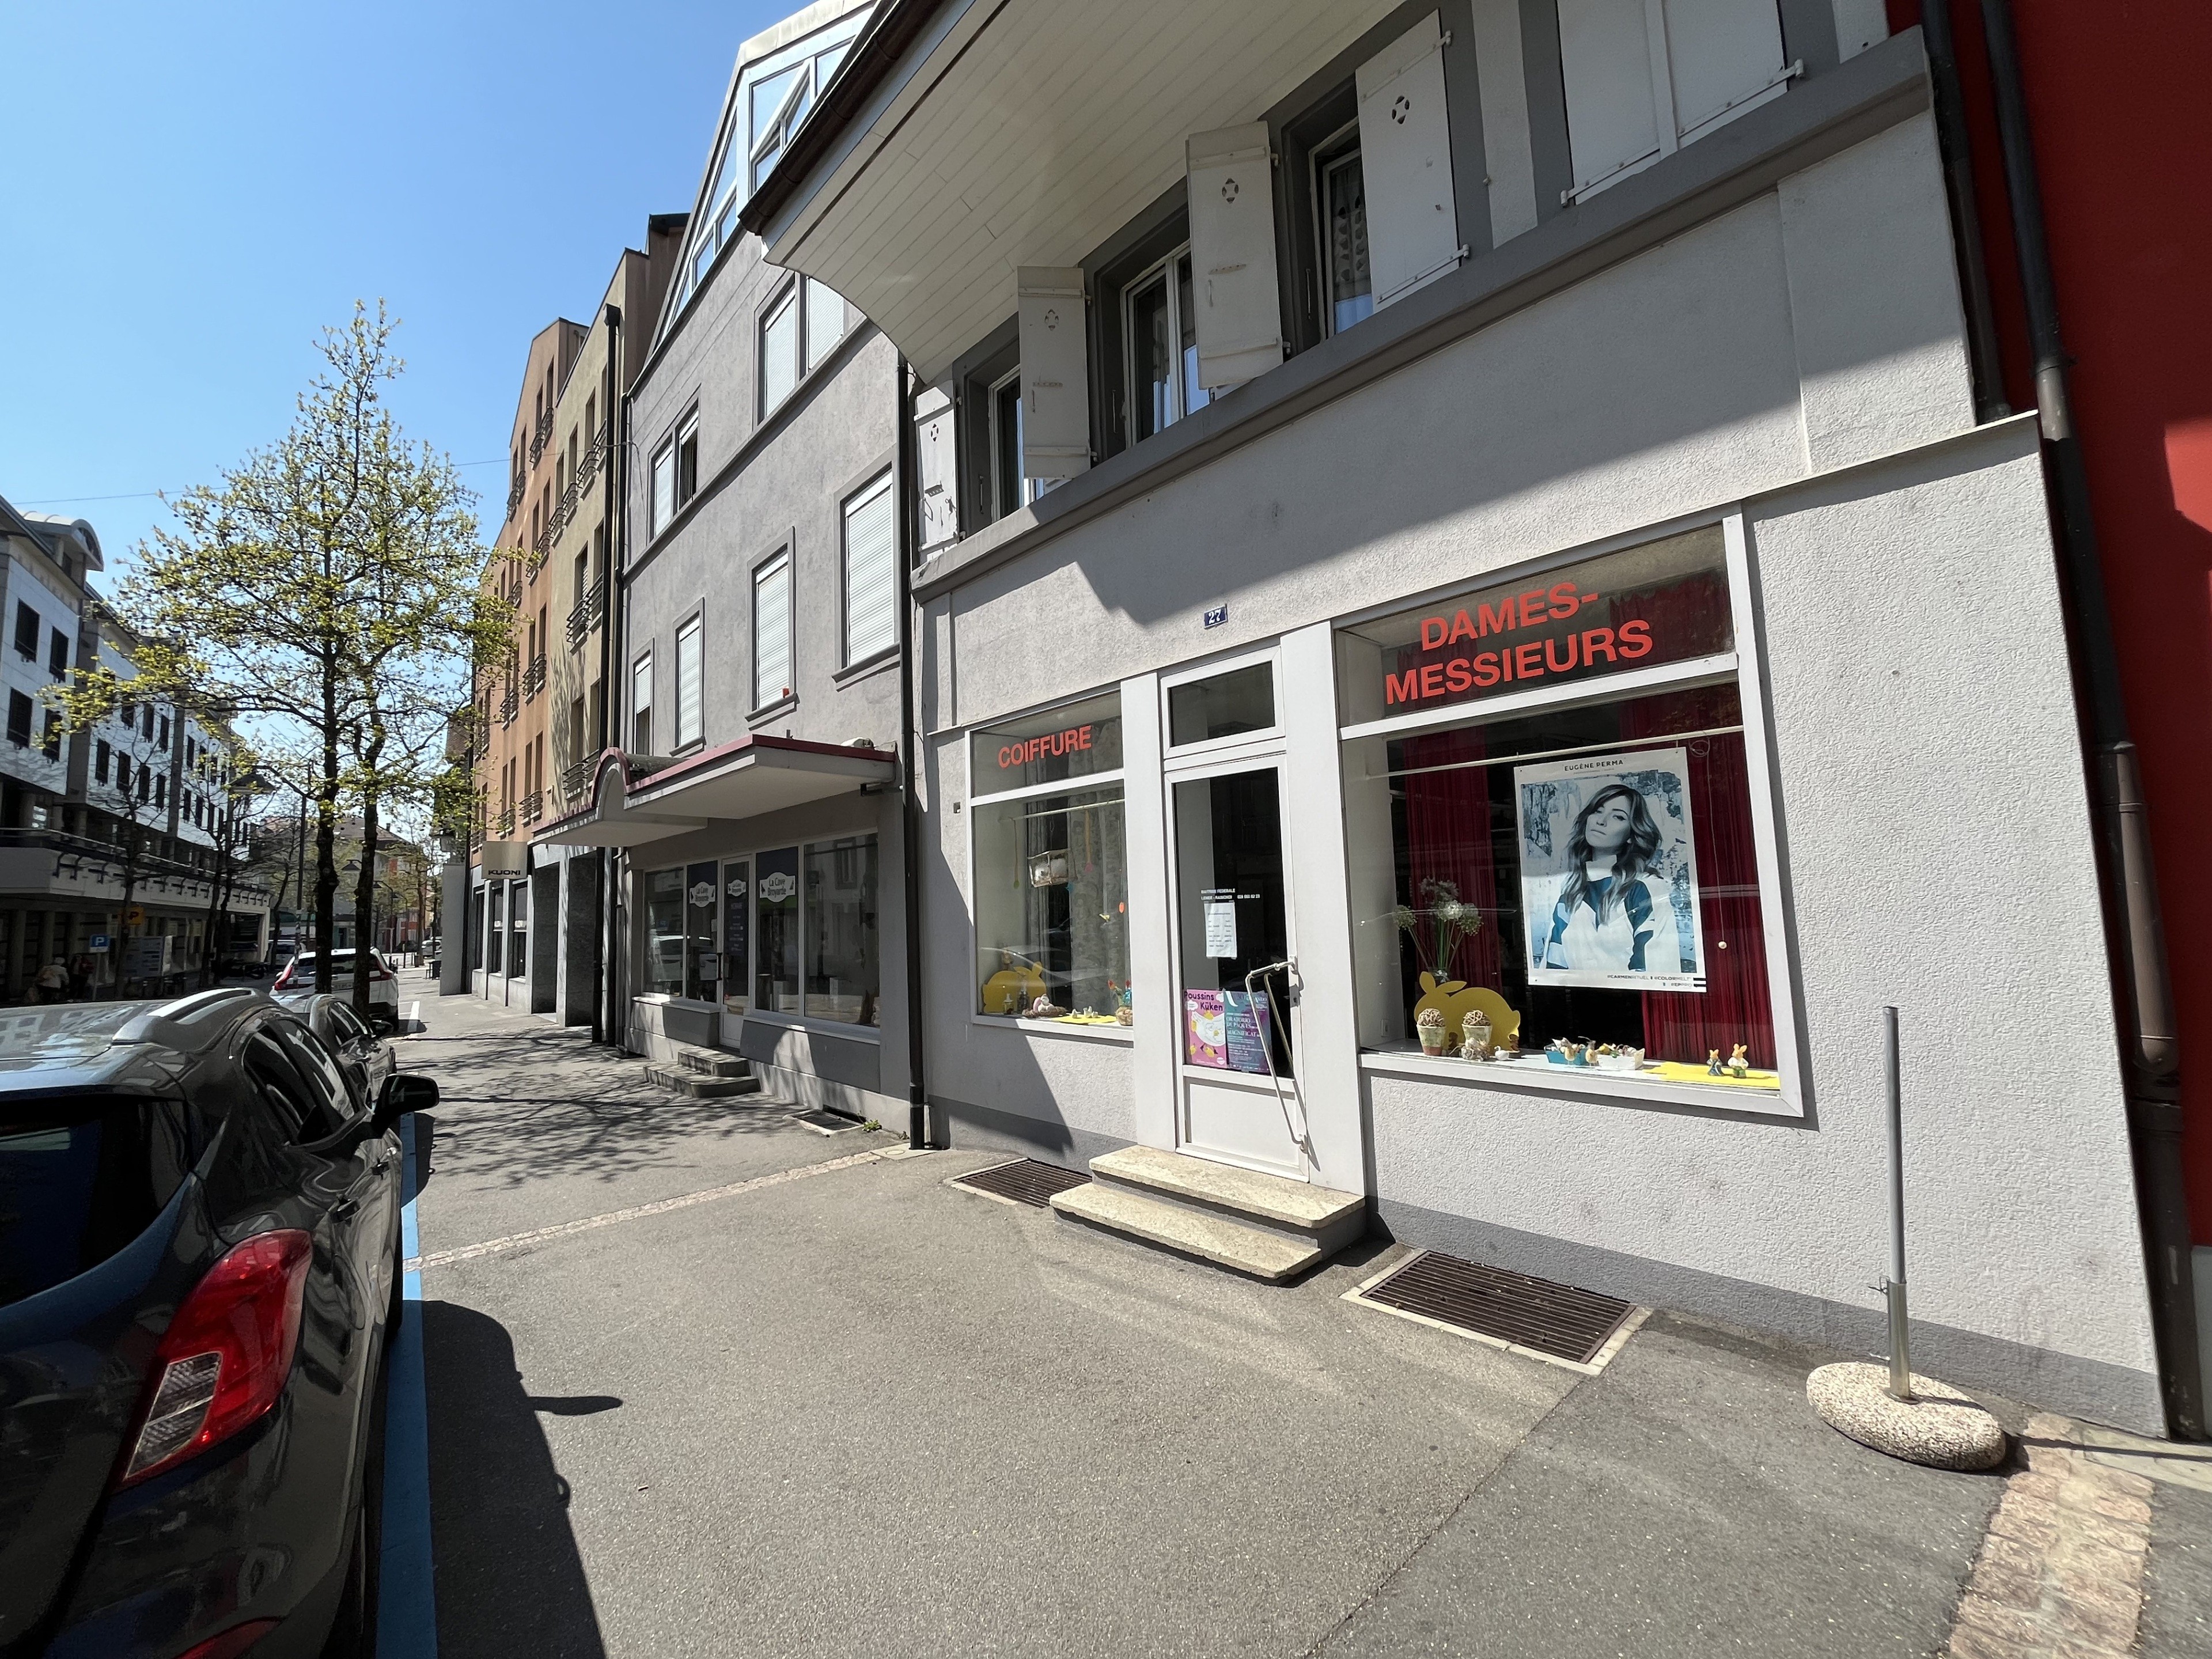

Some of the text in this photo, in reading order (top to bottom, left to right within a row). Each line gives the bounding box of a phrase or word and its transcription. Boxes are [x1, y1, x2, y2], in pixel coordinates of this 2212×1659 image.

[1208, 608, 1221, 624] 27
[1421, 582, 1599, 651] DAMES-
[1385, 620, 1653, 705] MESSIEURS
[998, 725, 1092, 768] COIFFURE
[1565, 762, 1594, 771] EUGÈNE
[769, 877, 785, 887] La Cave
[1184, 991, 1214, 1001] Poussins
[1200, 1002, 1224, 1011] Küken
